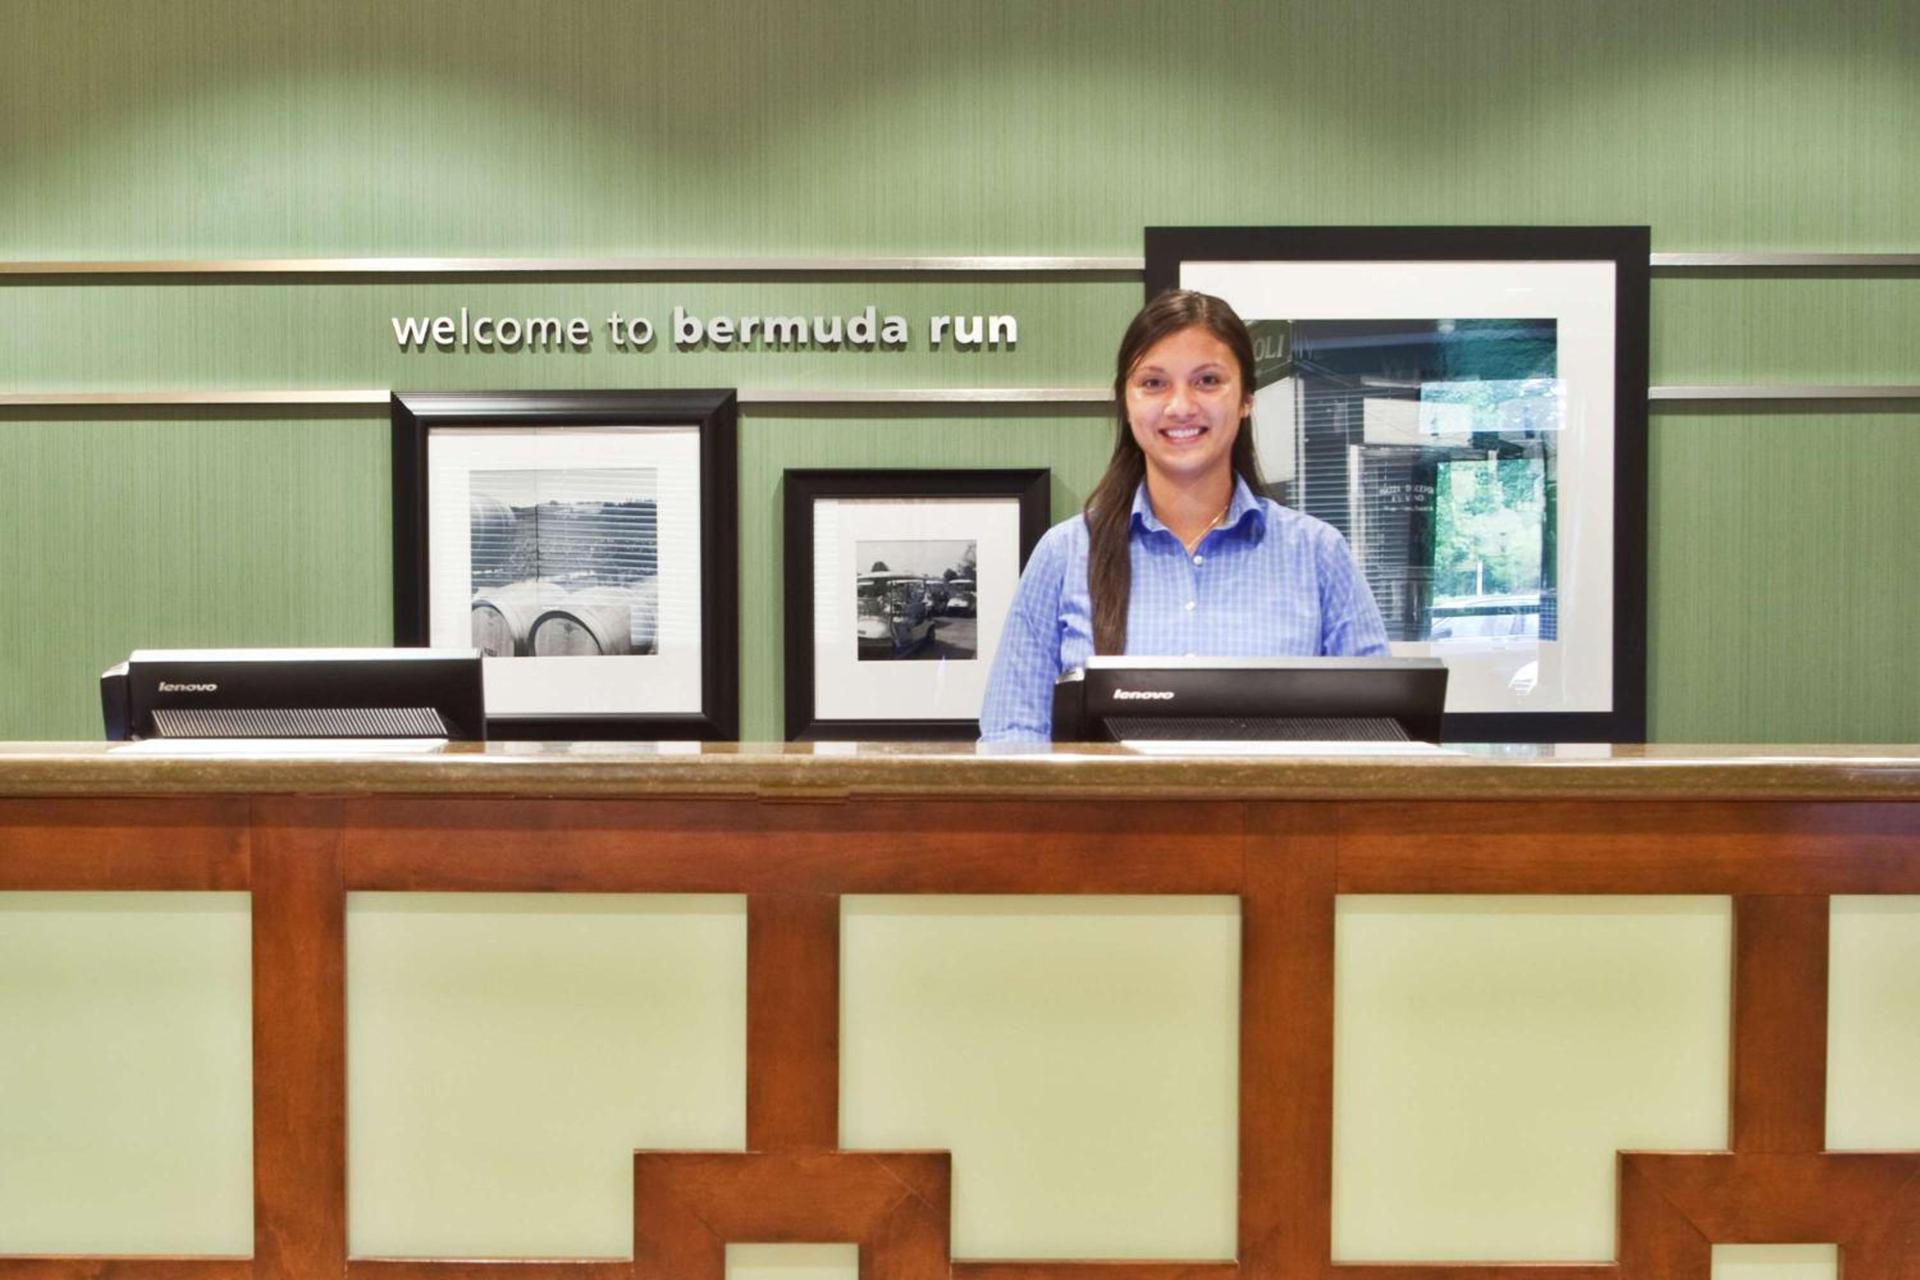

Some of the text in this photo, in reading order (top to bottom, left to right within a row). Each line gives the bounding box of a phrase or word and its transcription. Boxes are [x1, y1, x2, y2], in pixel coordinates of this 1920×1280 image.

[391, 305, 1018, 346] welcome to bermuda run
[158, 681, 218, 692] lenovo
[1113, 688, 1175, 700] lenovo
